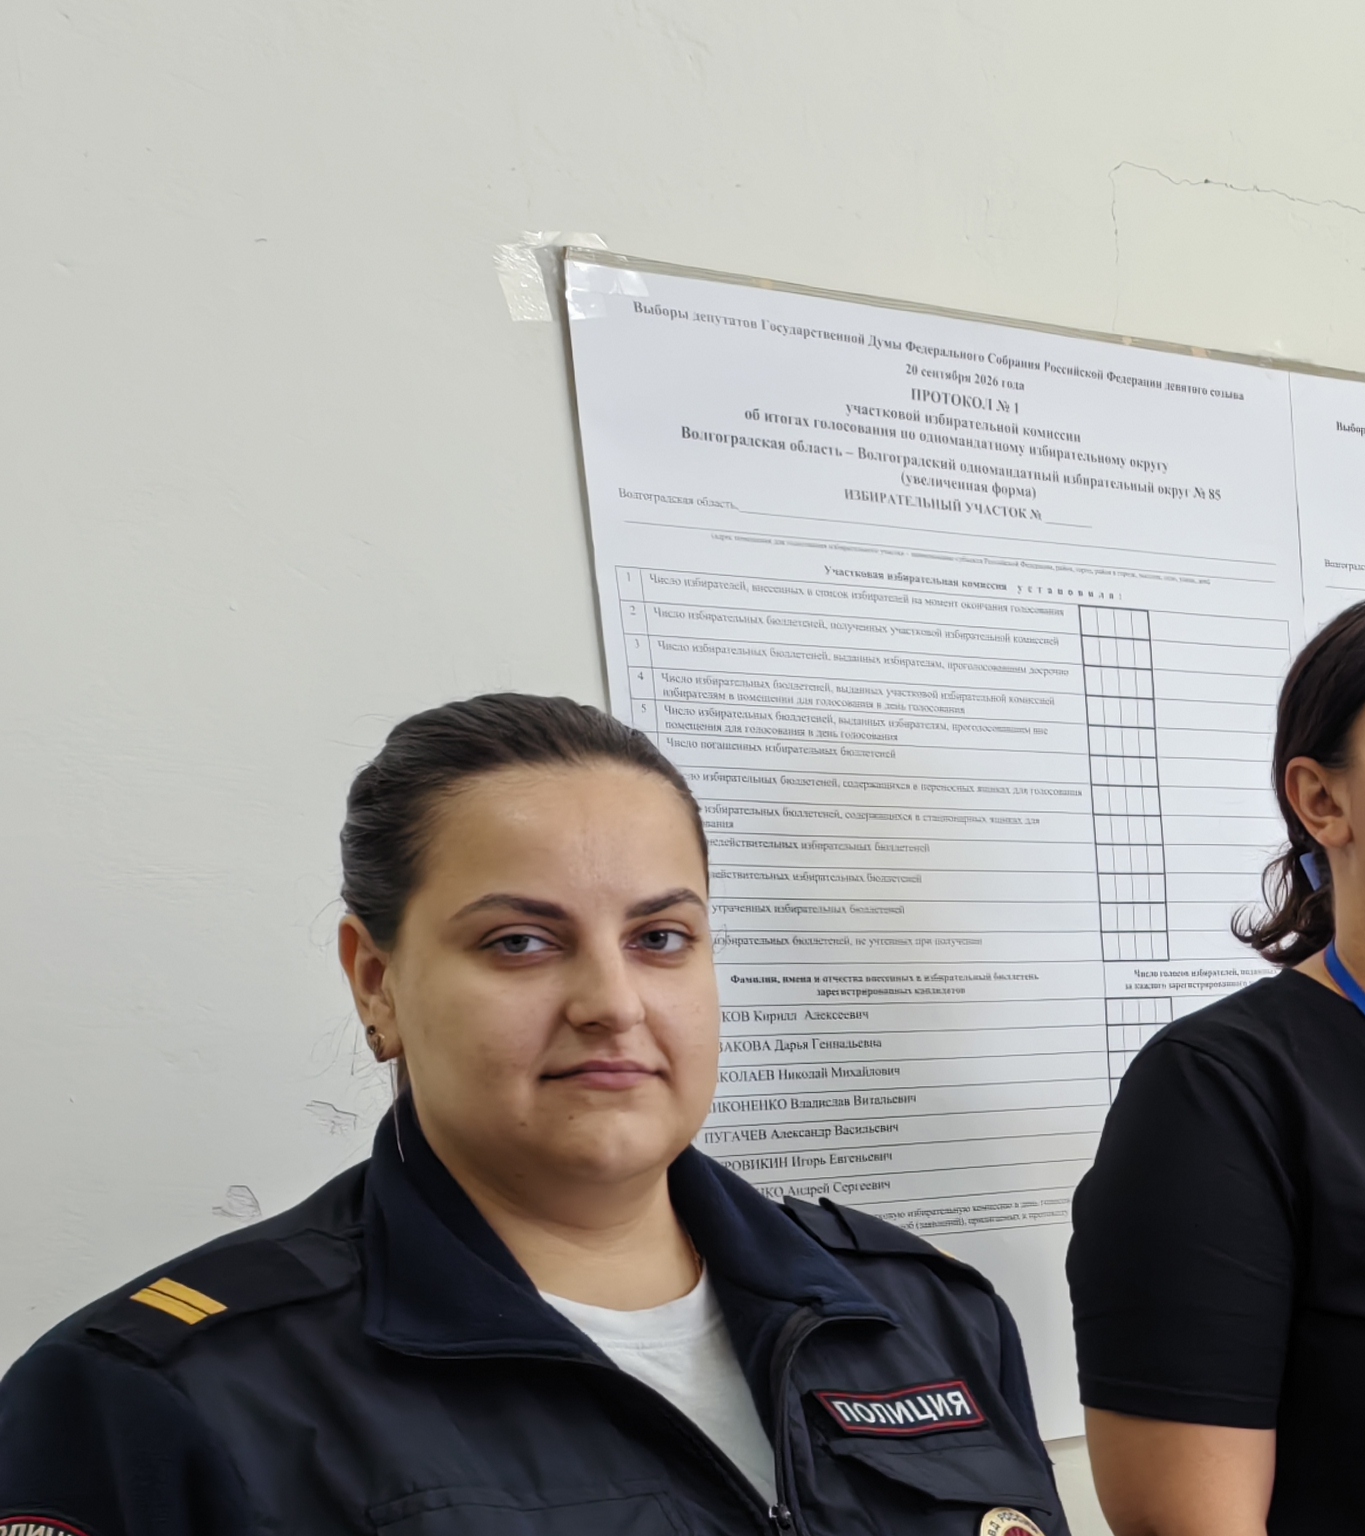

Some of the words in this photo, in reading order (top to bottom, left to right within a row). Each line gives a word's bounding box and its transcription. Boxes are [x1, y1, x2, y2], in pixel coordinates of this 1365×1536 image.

[632, 301, 689, 320] Выборы
[691, 312, 758, 329] депутатов
[760, 319, 865, 345] Государственной
[867, 335, 902, 350] Думы
[905, 341, 985, 362] Федерального
[987, 353, 1040, 370] Собрания
[1043, 361, 1103, 380] Российской
[1106, 371, 1161, 389] Федерации
[905, 363, 918, 376] 20
[920, 368, 971, 385] сентября
[973, 373, 999, 387] 2026
[1000, 379, 1025, 391] года
[910, 388, 992, 410] ПРОТОКОЛ
[995, 399, 1010, 413] №
[845, 404, 920, 422] участковой
[924, 413, 1019, 434] избирательной
[1022, 427, 1081, 443] комиссии
[743, 408, 760, 421] об
[763, 413, 809, 427] итогах
[813, 419, 896, 437] голосования
[899, 430, 916, 441] по
[918, 433, 1025, 456] одномандатному
[1028, 445, 1125, 468] избирательному
[1128, 459, 1167, 474] округу
[680, 426, 786, 450] Волгоградская
[788, 439, 843, 457] область
[857, 447, 956, 470] Волгоградский
[959, 463, 1059, 482] одномандатный
[1062, 473, 1154, 493] избирательный
[1156, 486, 1188, 500] округ
[1192, 486, 1206, 500] №
[1207, 488, 1221, 501] 85
[900, 473, 988, 493] (увеличенная
[990, 482, 1036, 499] форма)
[843, 489, 962, 512] ИЗБИРАТЕЛЬНЫЙ
[964, 502, 1027, 519] УЧАСТОК
[1029, 508, 1042, 521] №
[823, 565, 884, 580] Участковая
[886, 572, 959, 587] избирательная
[960, 580, 1007, 591] комиссия
[721, 1010, 750, 1023] КОВ
[753, 1010, 797, 1024] Кирилл
[804, 1010, 869, 1021] Алексеевич
[718, 1040, 770, 1053] ЗАКОВА
[774, 1039, 809, 1053] Дарья
[812, 1038, 882, 1050] Геннадьевна
[717, 1068, 775, 1083] КОЛАЕВ
[778, 1067, 829, 1080] Николай
[831, 1066, 900, 1079] Михайлович
[709, 1098, 787, 1114] ИКОНЕНКО
[790, 1097, 850, 1110] Владислав
[853, 1094, 917, 1106] Витальевич
[704, 1129, 767, 1144] ПУГАЧЕВ
[770, 1127, 832, 1140] Александр
[834, 1123, 899, 1137] Васильевич
[718, 1156, 788, 1171] РОВИКИН
[792, 1155, 827, 1169] Игорь
[829, 1152, 893, 1165] Евгеньевич
[788, 1182, 830, 1198] Андрей
[833, 1180, 891, 1194] Сергеевич
[831, 1391, 972, 1424] ПОЛИЦИЯ
